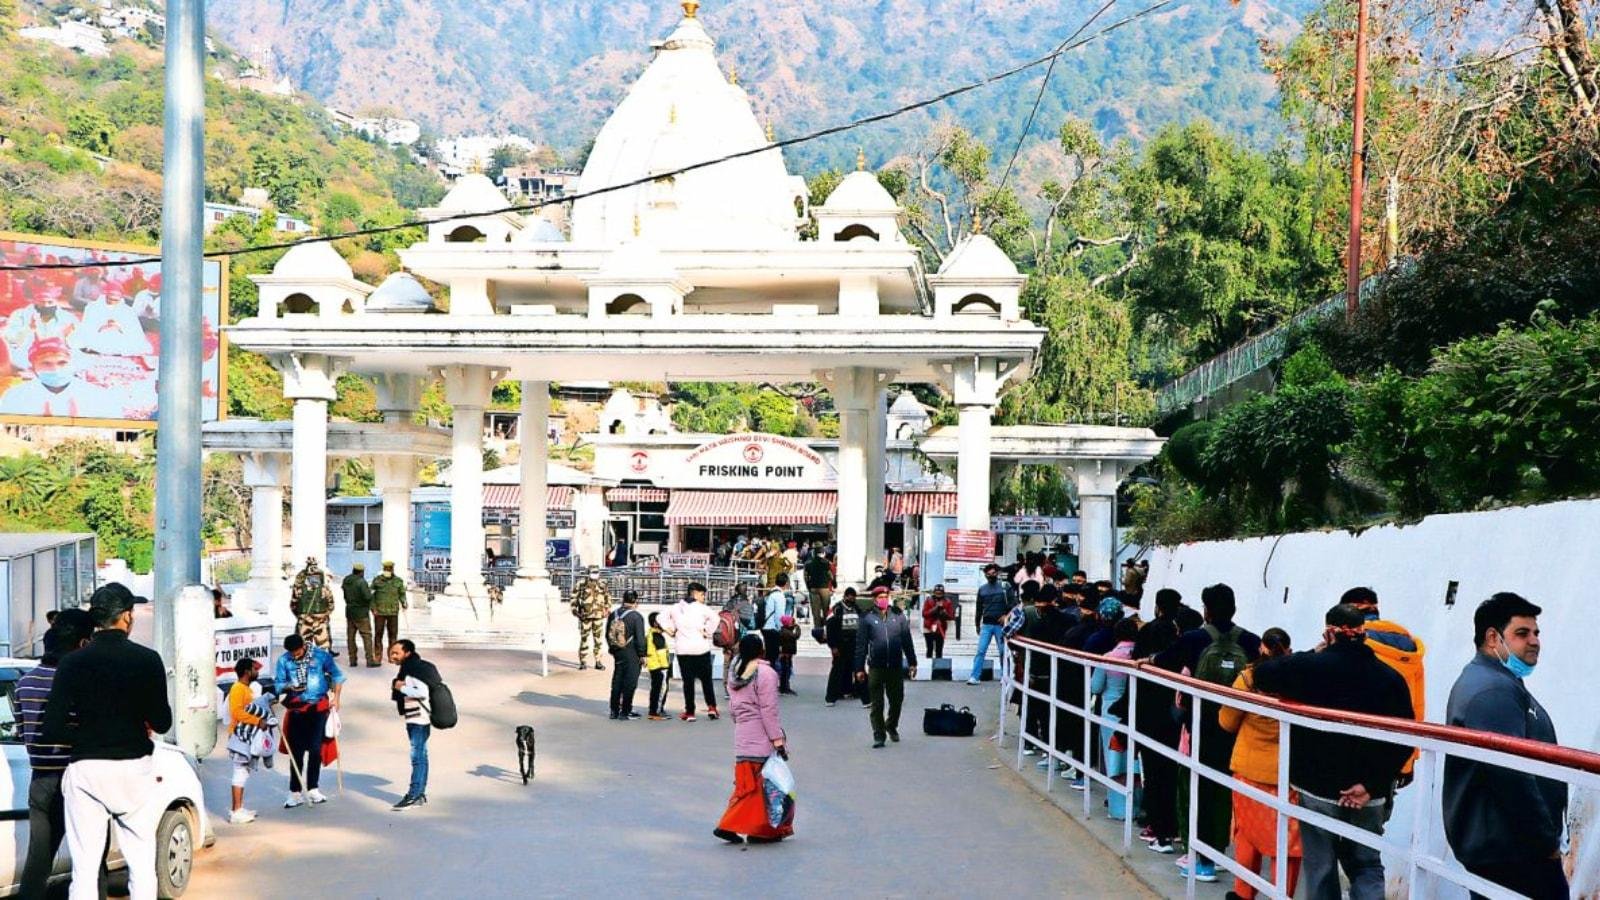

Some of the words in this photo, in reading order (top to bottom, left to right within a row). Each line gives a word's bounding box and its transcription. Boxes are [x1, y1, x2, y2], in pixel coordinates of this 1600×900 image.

[699, 442, 718, 453] MATA
[699, 464, 759, 477] FRISKING
[765, 465, 805, 478] POINT
[221, 650, 232, 662] TO
[232, 645, 268, 661] BHAWAN
